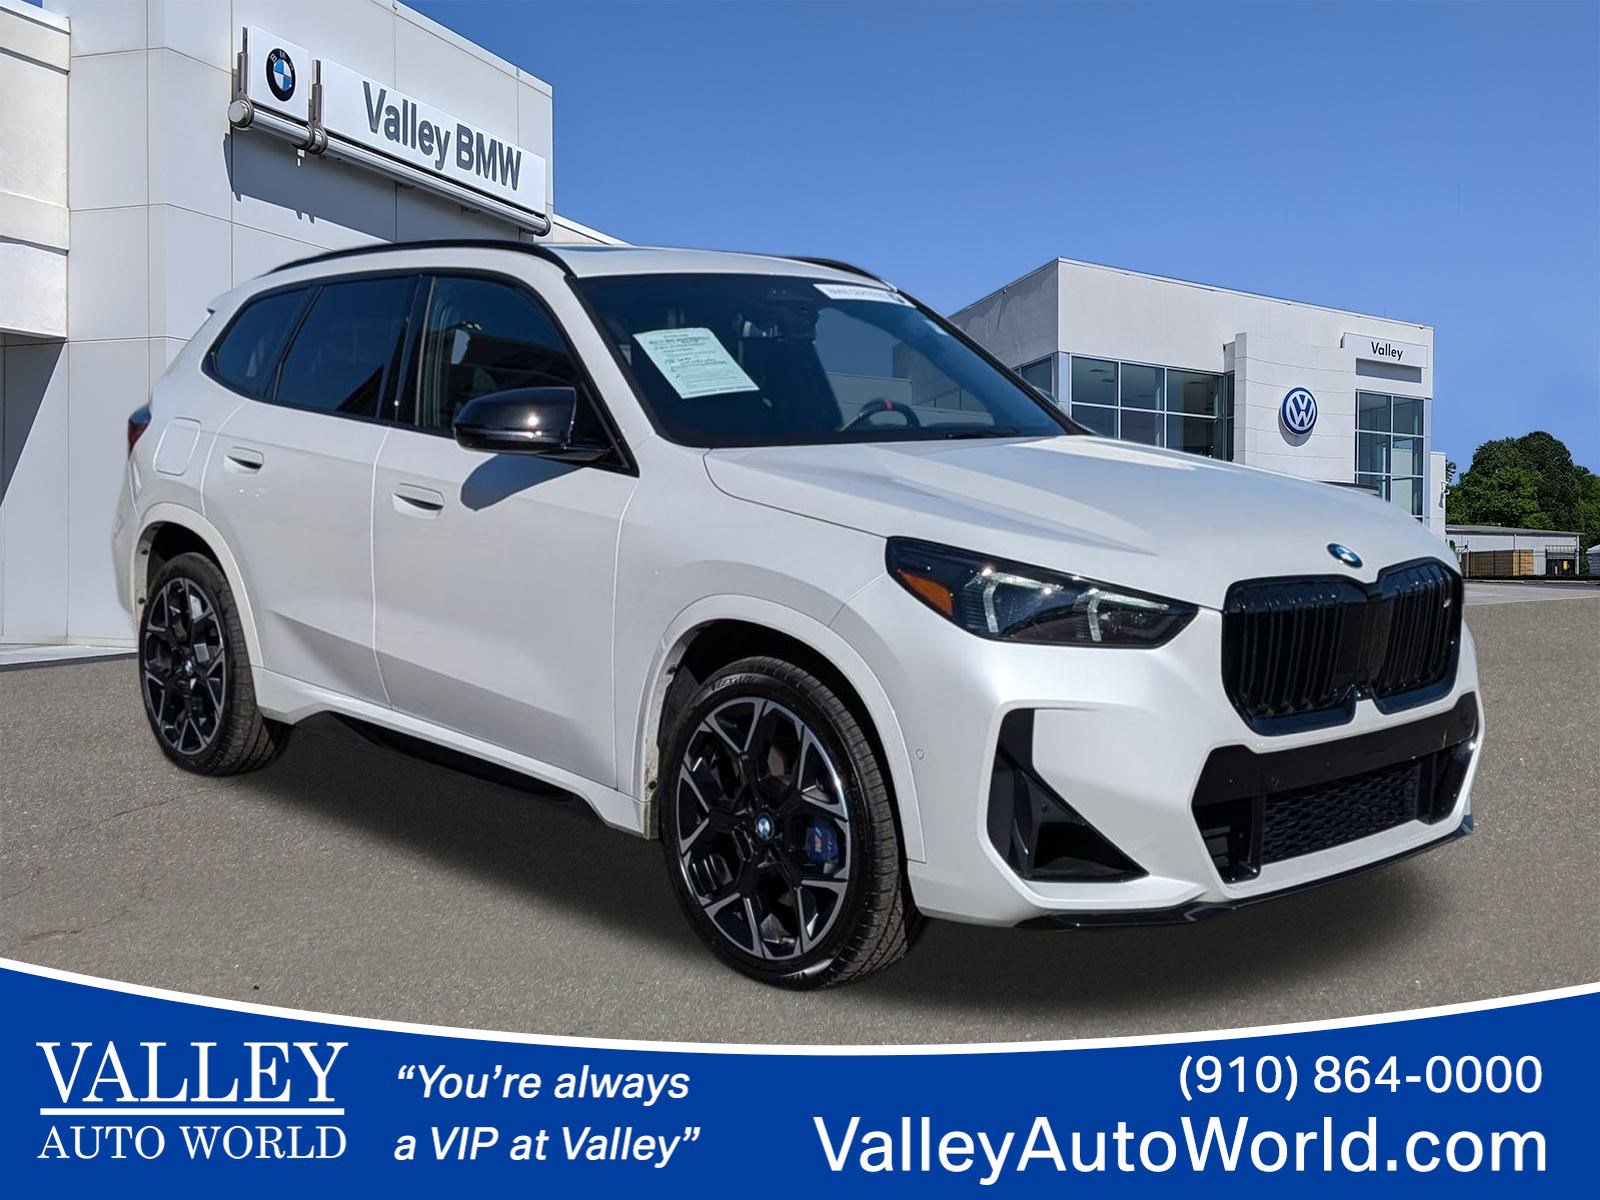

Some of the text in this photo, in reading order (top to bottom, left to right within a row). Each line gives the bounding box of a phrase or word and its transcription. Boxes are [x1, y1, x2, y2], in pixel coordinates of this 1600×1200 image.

[362, 81, 522, 191] Valley BMW
[1371, 341, 1404, 361] Valley
